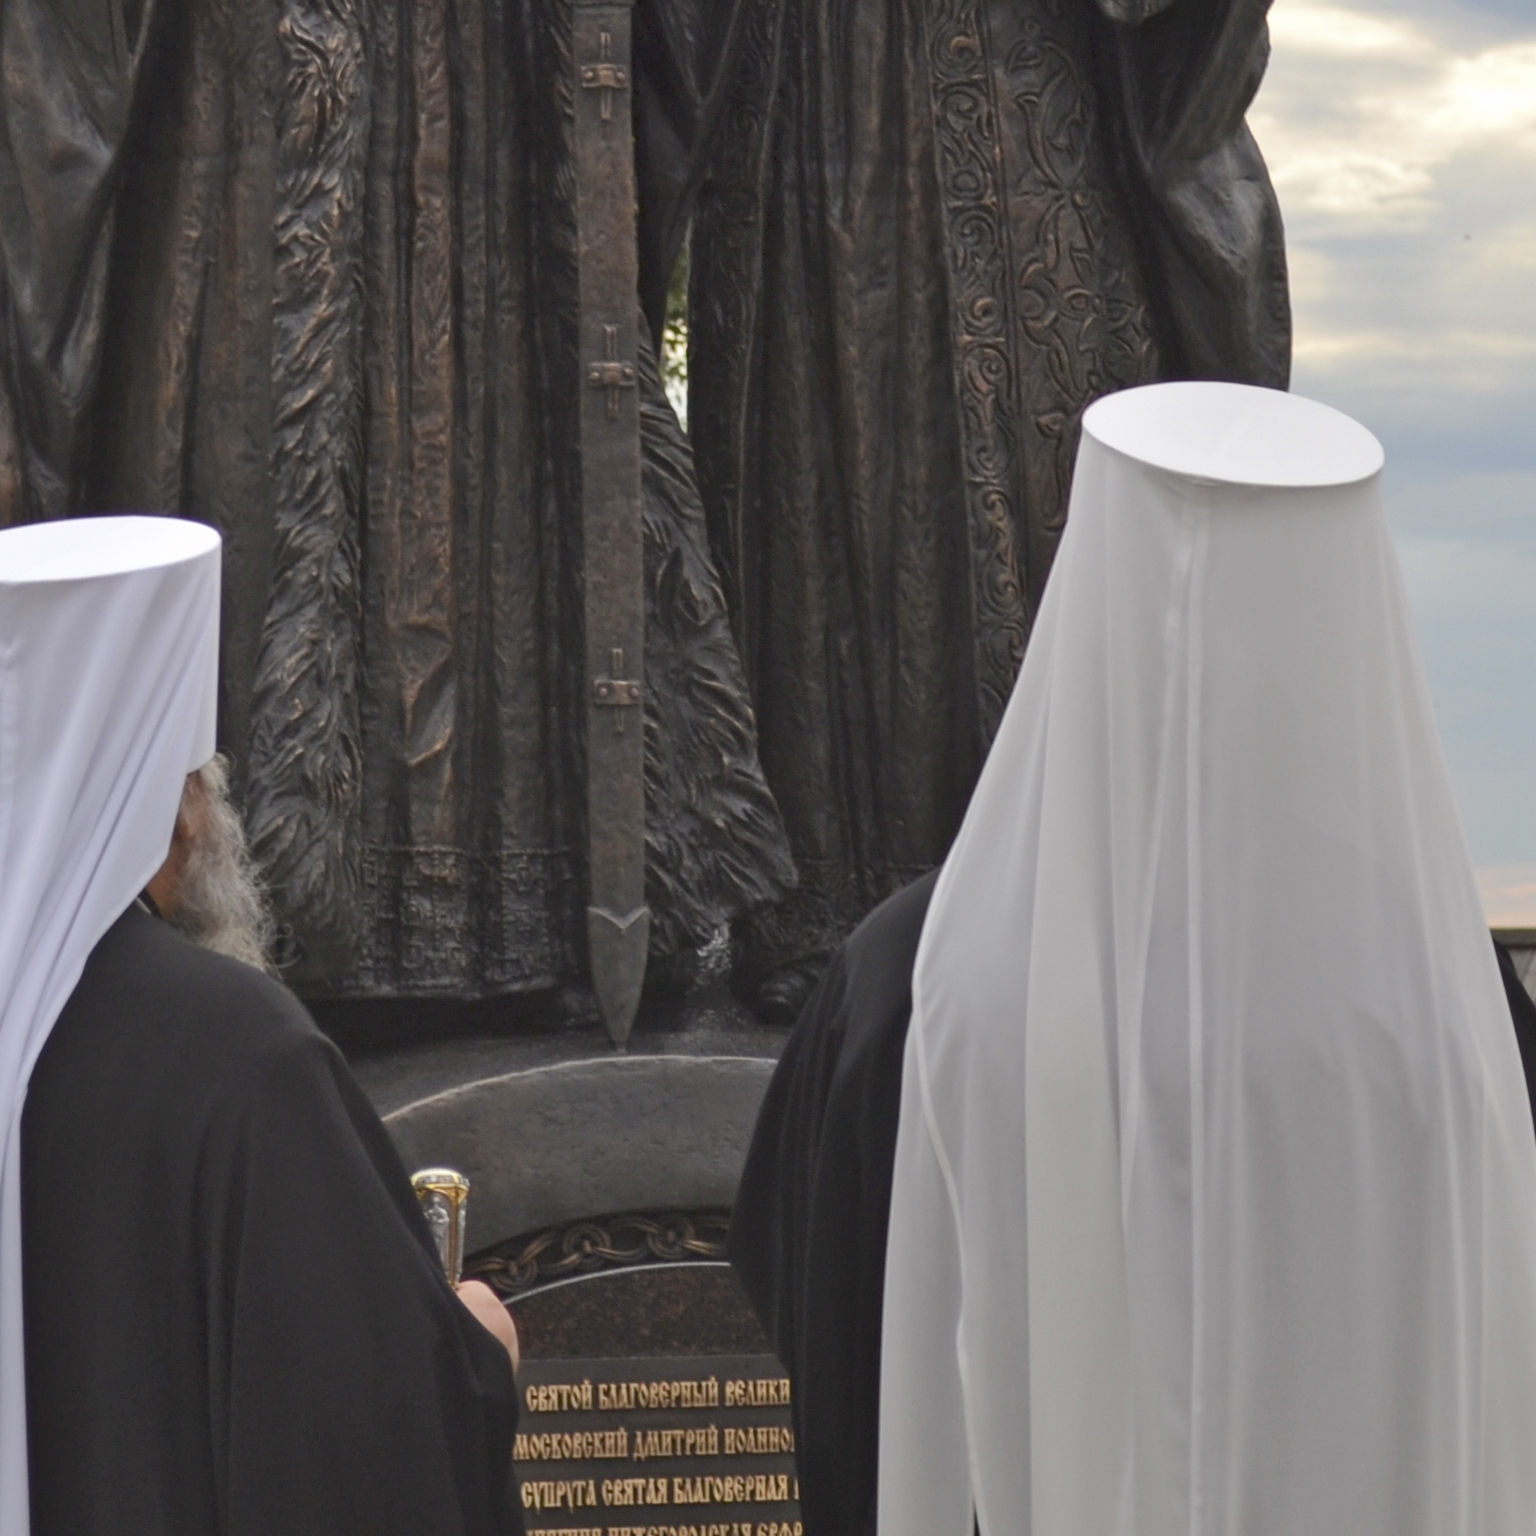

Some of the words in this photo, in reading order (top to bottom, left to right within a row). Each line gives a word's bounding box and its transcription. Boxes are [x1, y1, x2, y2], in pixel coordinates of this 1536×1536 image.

[526, 1379, 593, 1412] СВЯТОЙ
[598, 1375, 719, 1410] БЛАГОВЕРНЫЙ
[513, 1427, 628, 1460] МОСКОВСКИЙ
[633, 1424, 719, 1461] ДМИТРИЙ
[724, 1427, 795, 1454] ИОАННО
[601, 1478, 668, 1506] СВЯТАЯ
[673, 1474, 789, 1503] БЛАГОВЕРНАЯ
